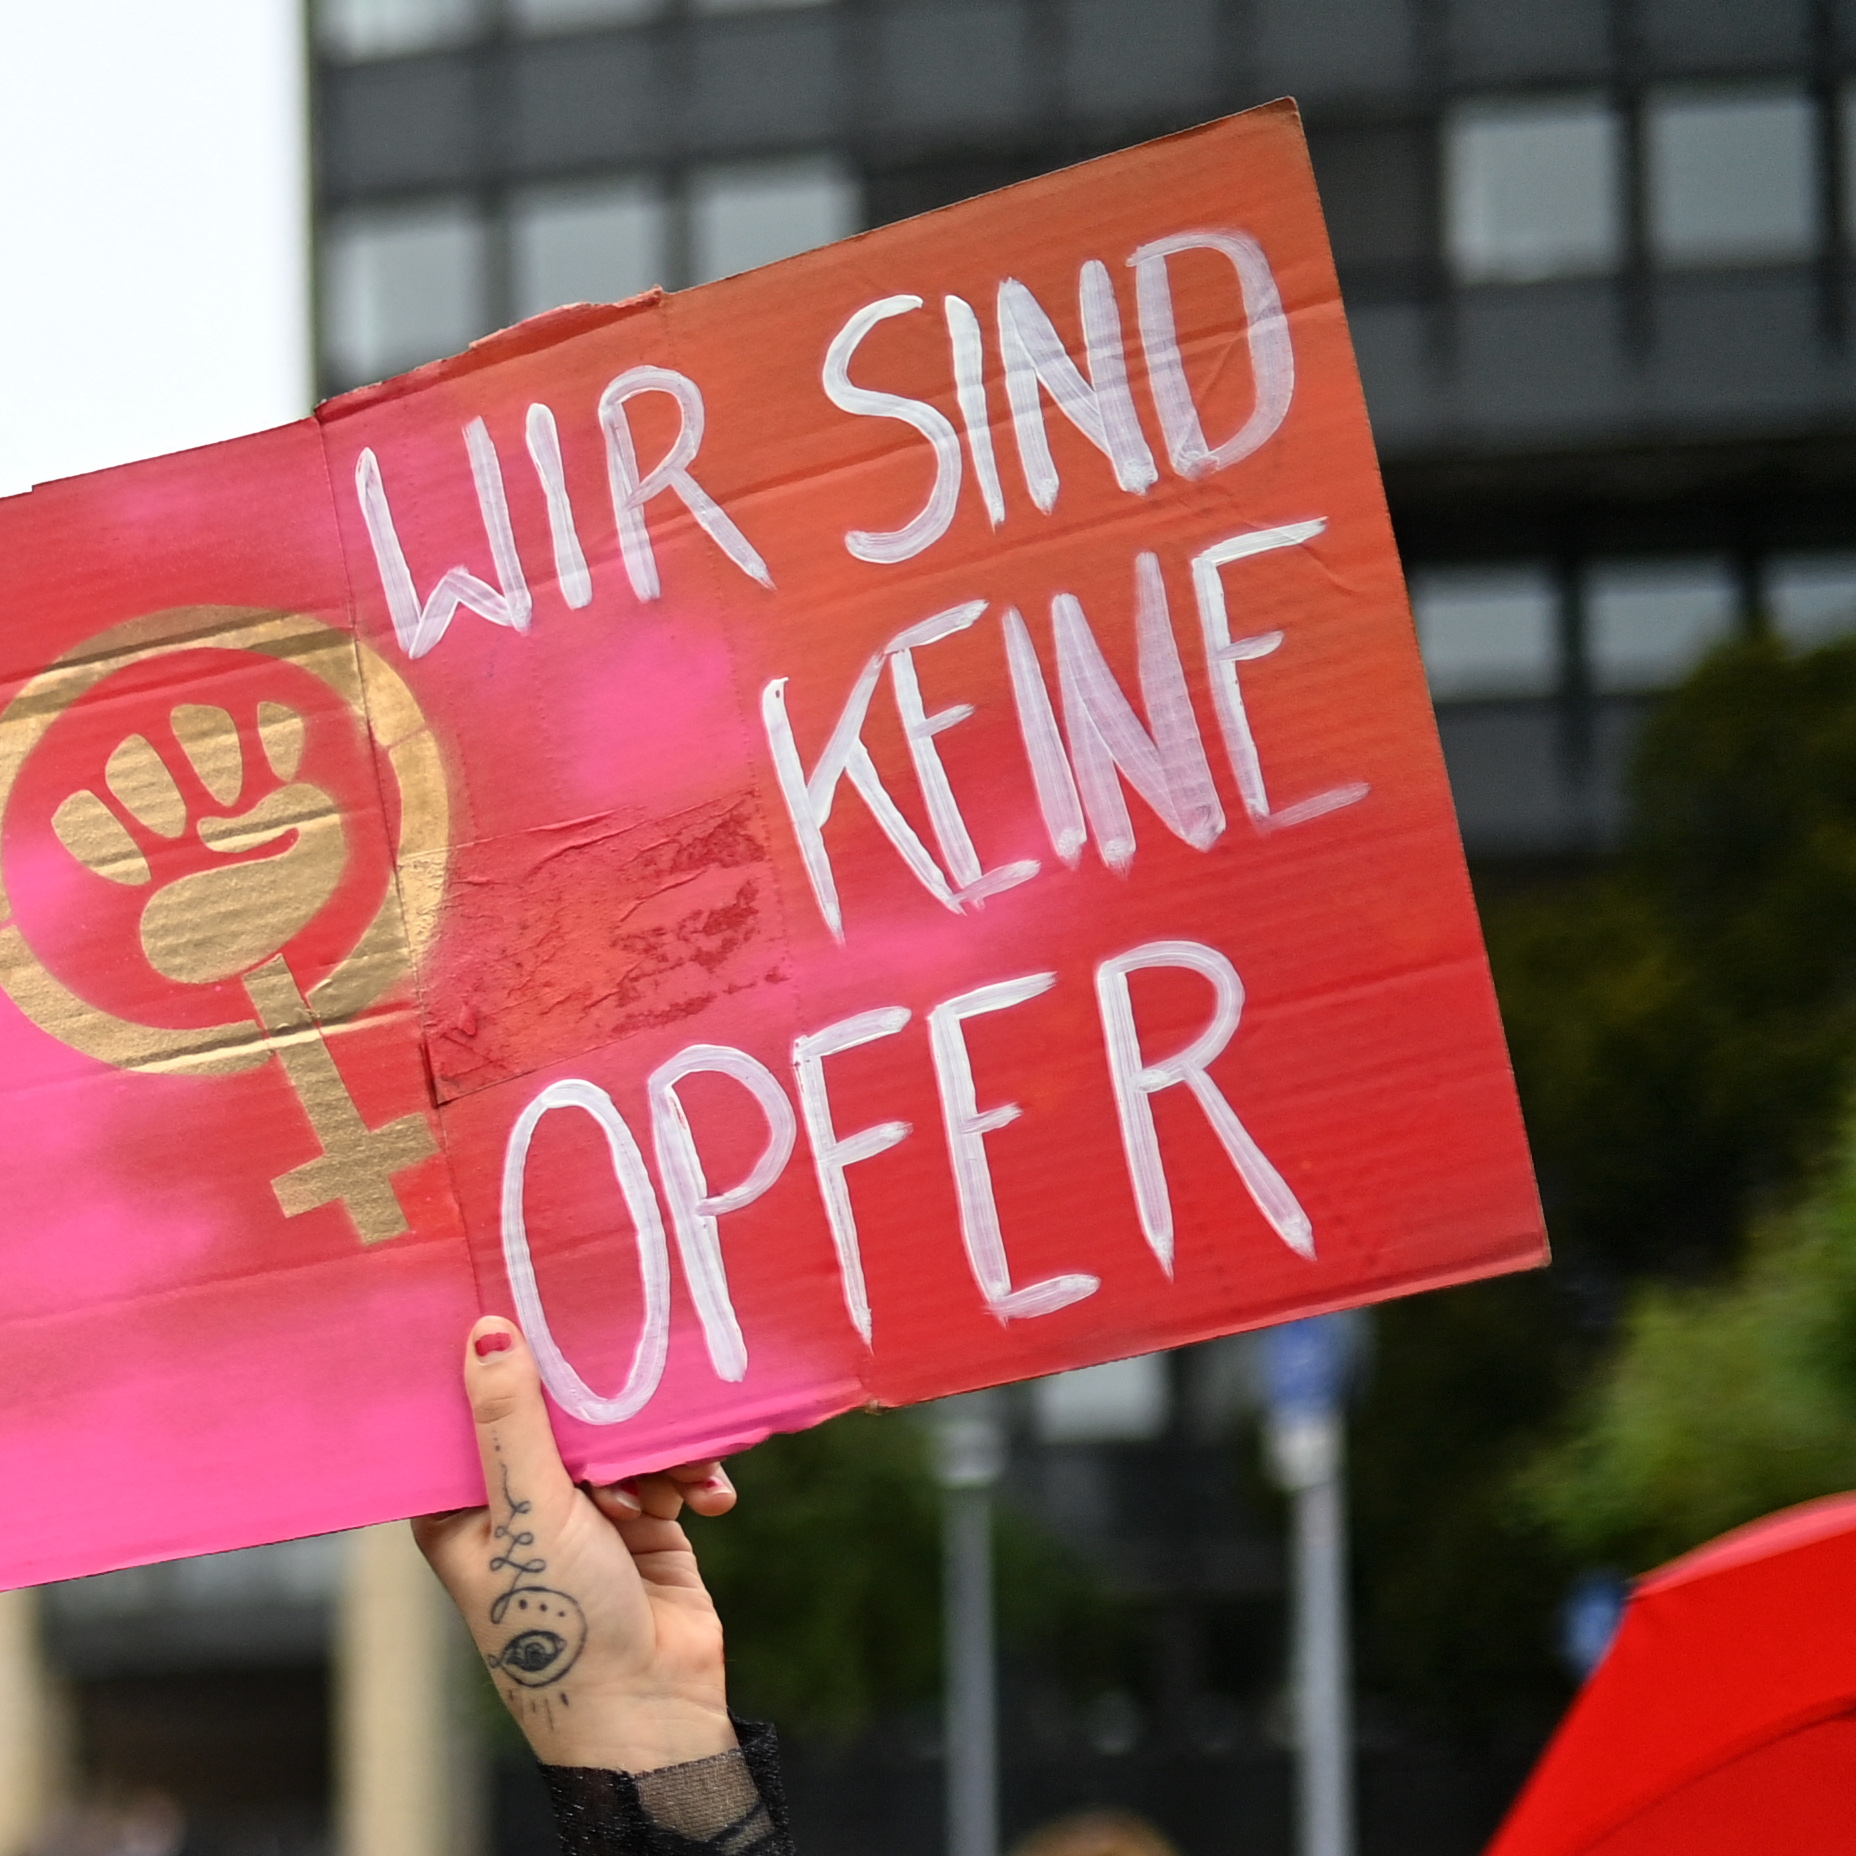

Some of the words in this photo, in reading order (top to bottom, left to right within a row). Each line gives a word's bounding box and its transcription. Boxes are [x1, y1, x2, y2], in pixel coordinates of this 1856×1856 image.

[355, 363, 776, 661] WIR
[821, 227, 1296, 565] SIND
[759, 516, 1371, 942] KEINE
[499, 939, 1317, 1425] OPFER
